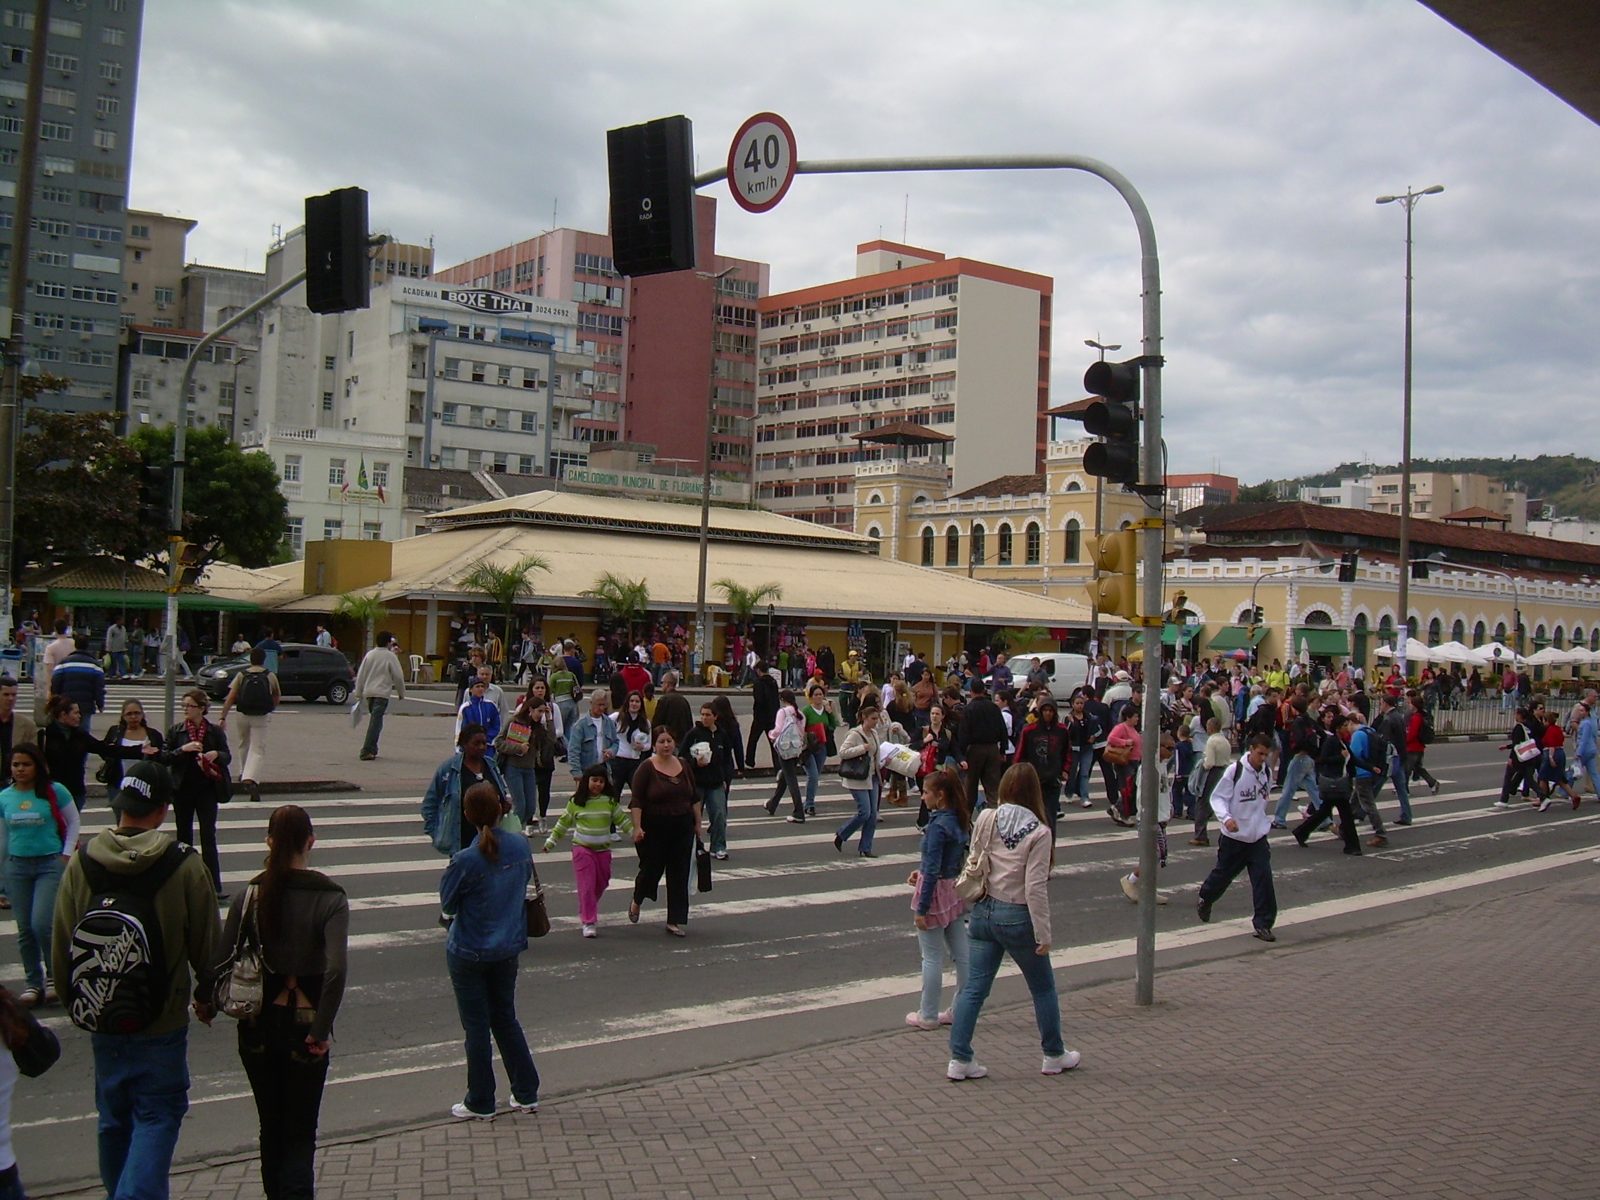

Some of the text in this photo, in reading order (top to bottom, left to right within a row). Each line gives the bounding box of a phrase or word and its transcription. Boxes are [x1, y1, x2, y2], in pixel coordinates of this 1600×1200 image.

[744, 134, 780, 174] 40
[747, 175, 778, 195] km/h
[402, 286, 438, 298] ACADEMIA
[448, 292, 486, 308] BOXE
[491, 296, 526, 311] THAI
[535, 305, 552, 315] 3024
[568, 469, 619, 485] CAMELODROMO
[622, 475, 656, 489] MUNICIPAL
[659, 479, 669, 491] DE
[72, 923, 142, 1032] Billabong
